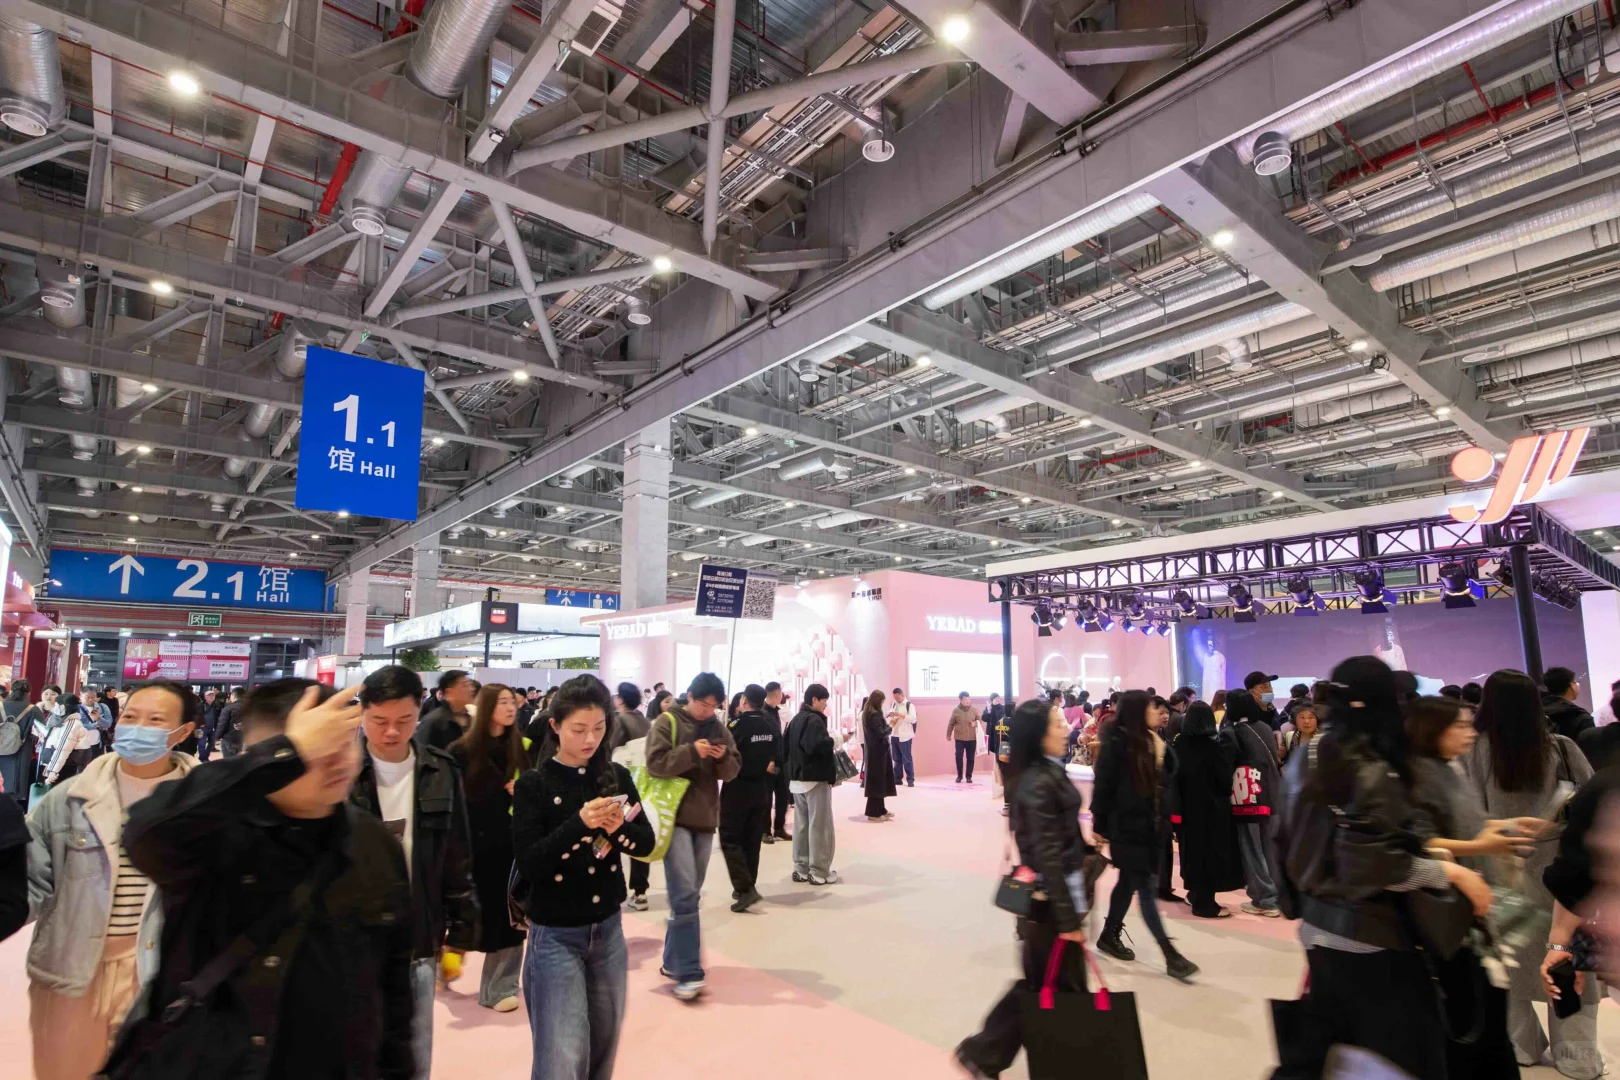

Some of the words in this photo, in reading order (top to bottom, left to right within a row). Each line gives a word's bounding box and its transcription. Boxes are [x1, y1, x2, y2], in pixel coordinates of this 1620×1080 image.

[333, 394, 396, 447] 1.1
[328, 446, 355, 472] 馆
[360, 461, 396, 478] Hall
[173, 559, 244, 601] 2.1
[258, 565, 290, 592] 馆
[256, 591, 290, 603] Hall
